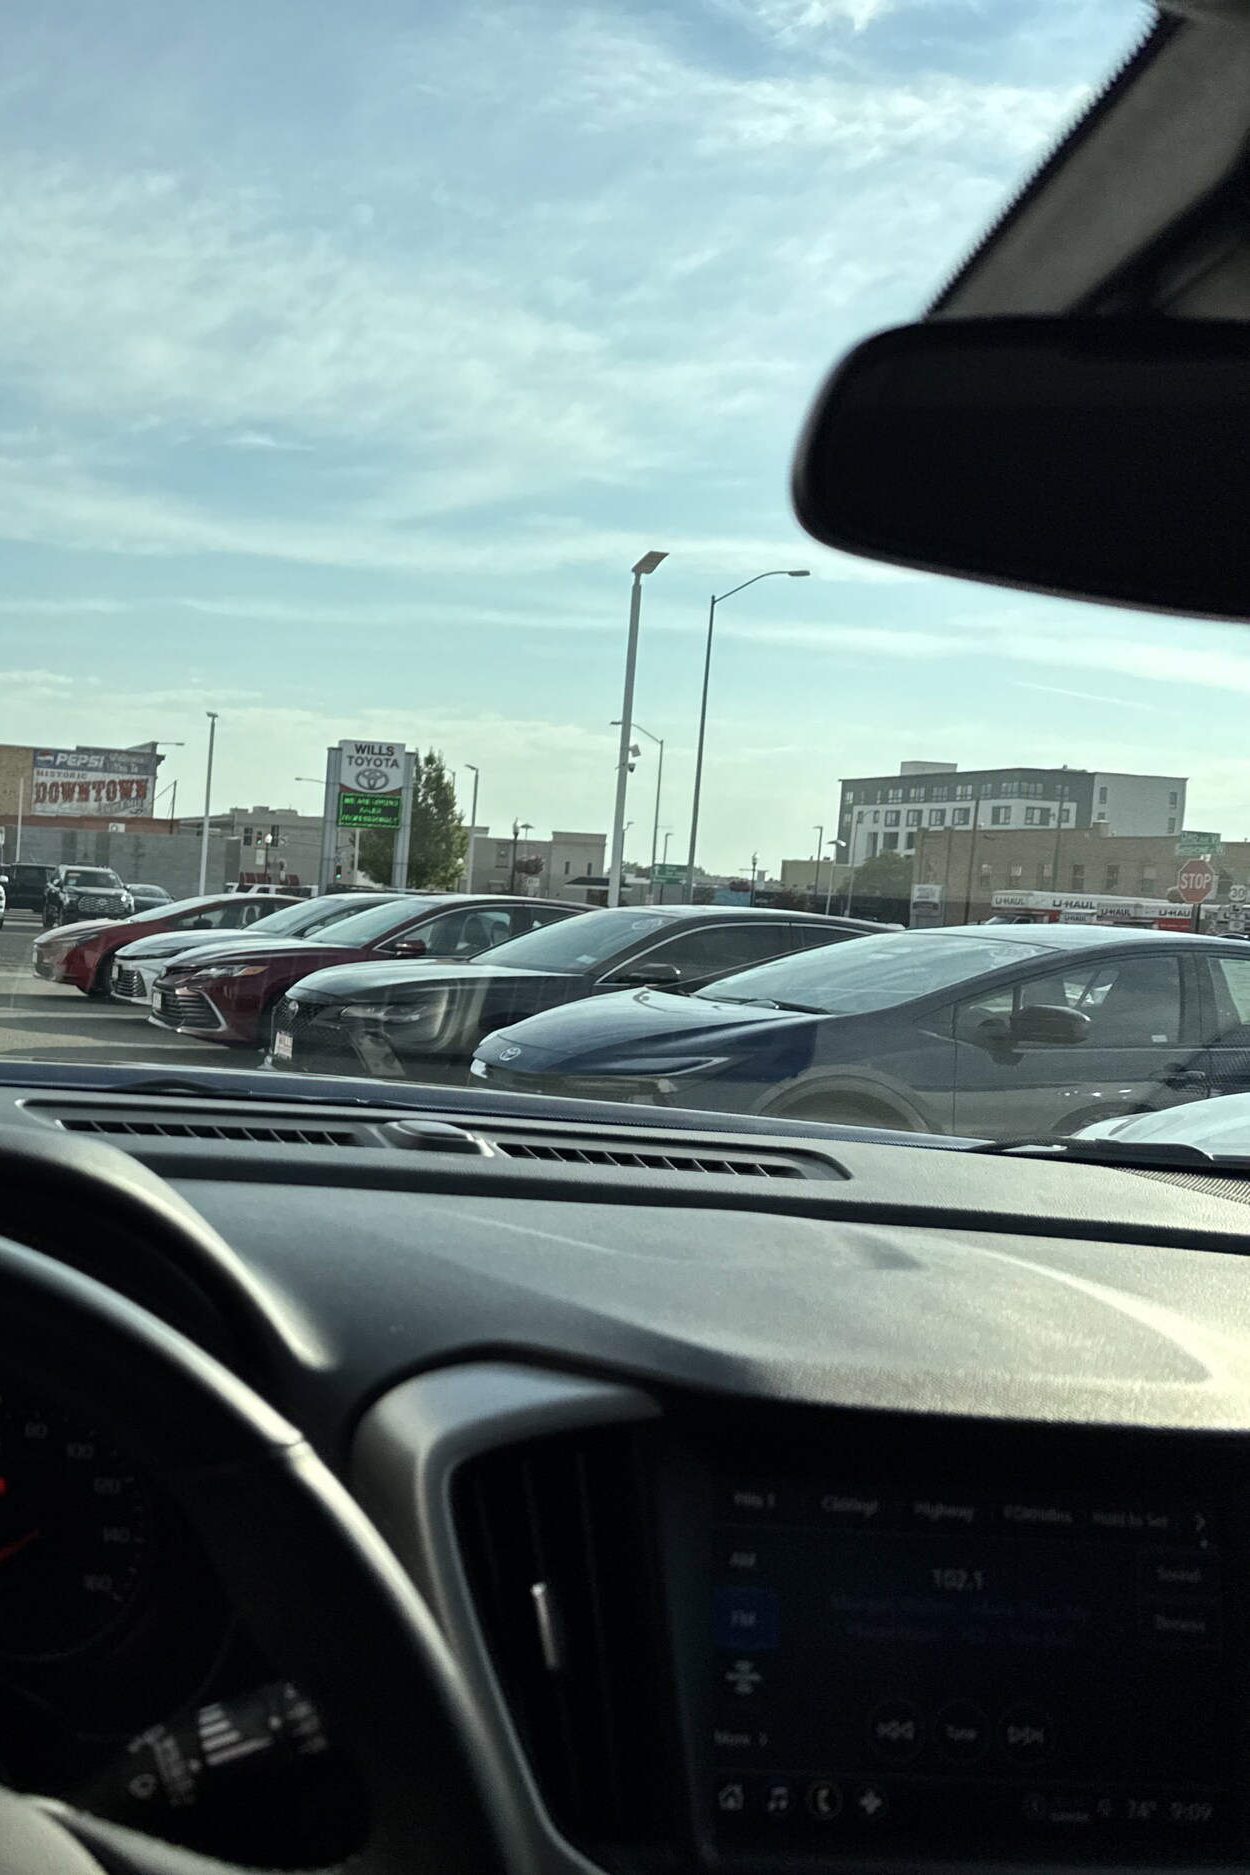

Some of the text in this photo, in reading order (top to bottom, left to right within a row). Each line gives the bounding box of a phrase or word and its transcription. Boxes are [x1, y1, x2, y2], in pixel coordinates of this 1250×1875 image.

[354, 743, 395, 757] WILLS
[55, 753, 104, 769] PEPSI
[346, 755, 400, 769] TOYOTA
[36, 770, 88, 780] HISTORIC
[34, 779, 148, 803] DOWNTOWN
[1181, 832, 1199, 843] 3RD
[1181, 873, 1211, 889] STOP
[1230, 888, 1245, 898] 30
[995, 897, 1025, 906] U-HAUL
[1052, 900, 1096, 910] U-HAUL
[1101, 908, 1131, 917] U-HAUL
[1159, 909, 1191, 917] U-HAU
